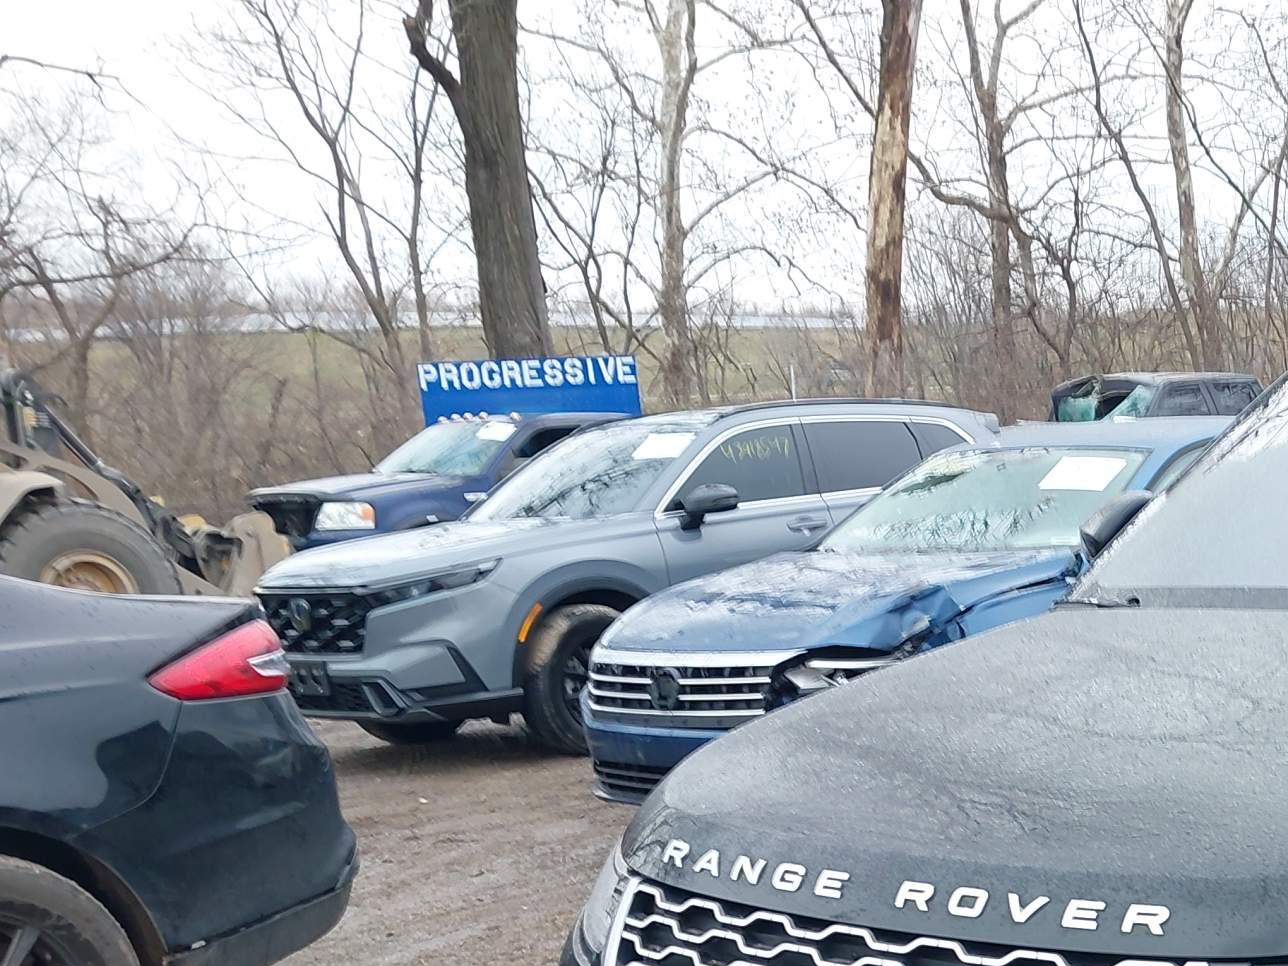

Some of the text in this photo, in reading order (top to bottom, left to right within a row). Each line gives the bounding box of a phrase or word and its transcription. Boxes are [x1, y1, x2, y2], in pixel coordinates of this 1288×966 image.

[417, 356, 637, 391] PROGRESSIVE
[662, 839, 1171, 936] RANGE ROVER
